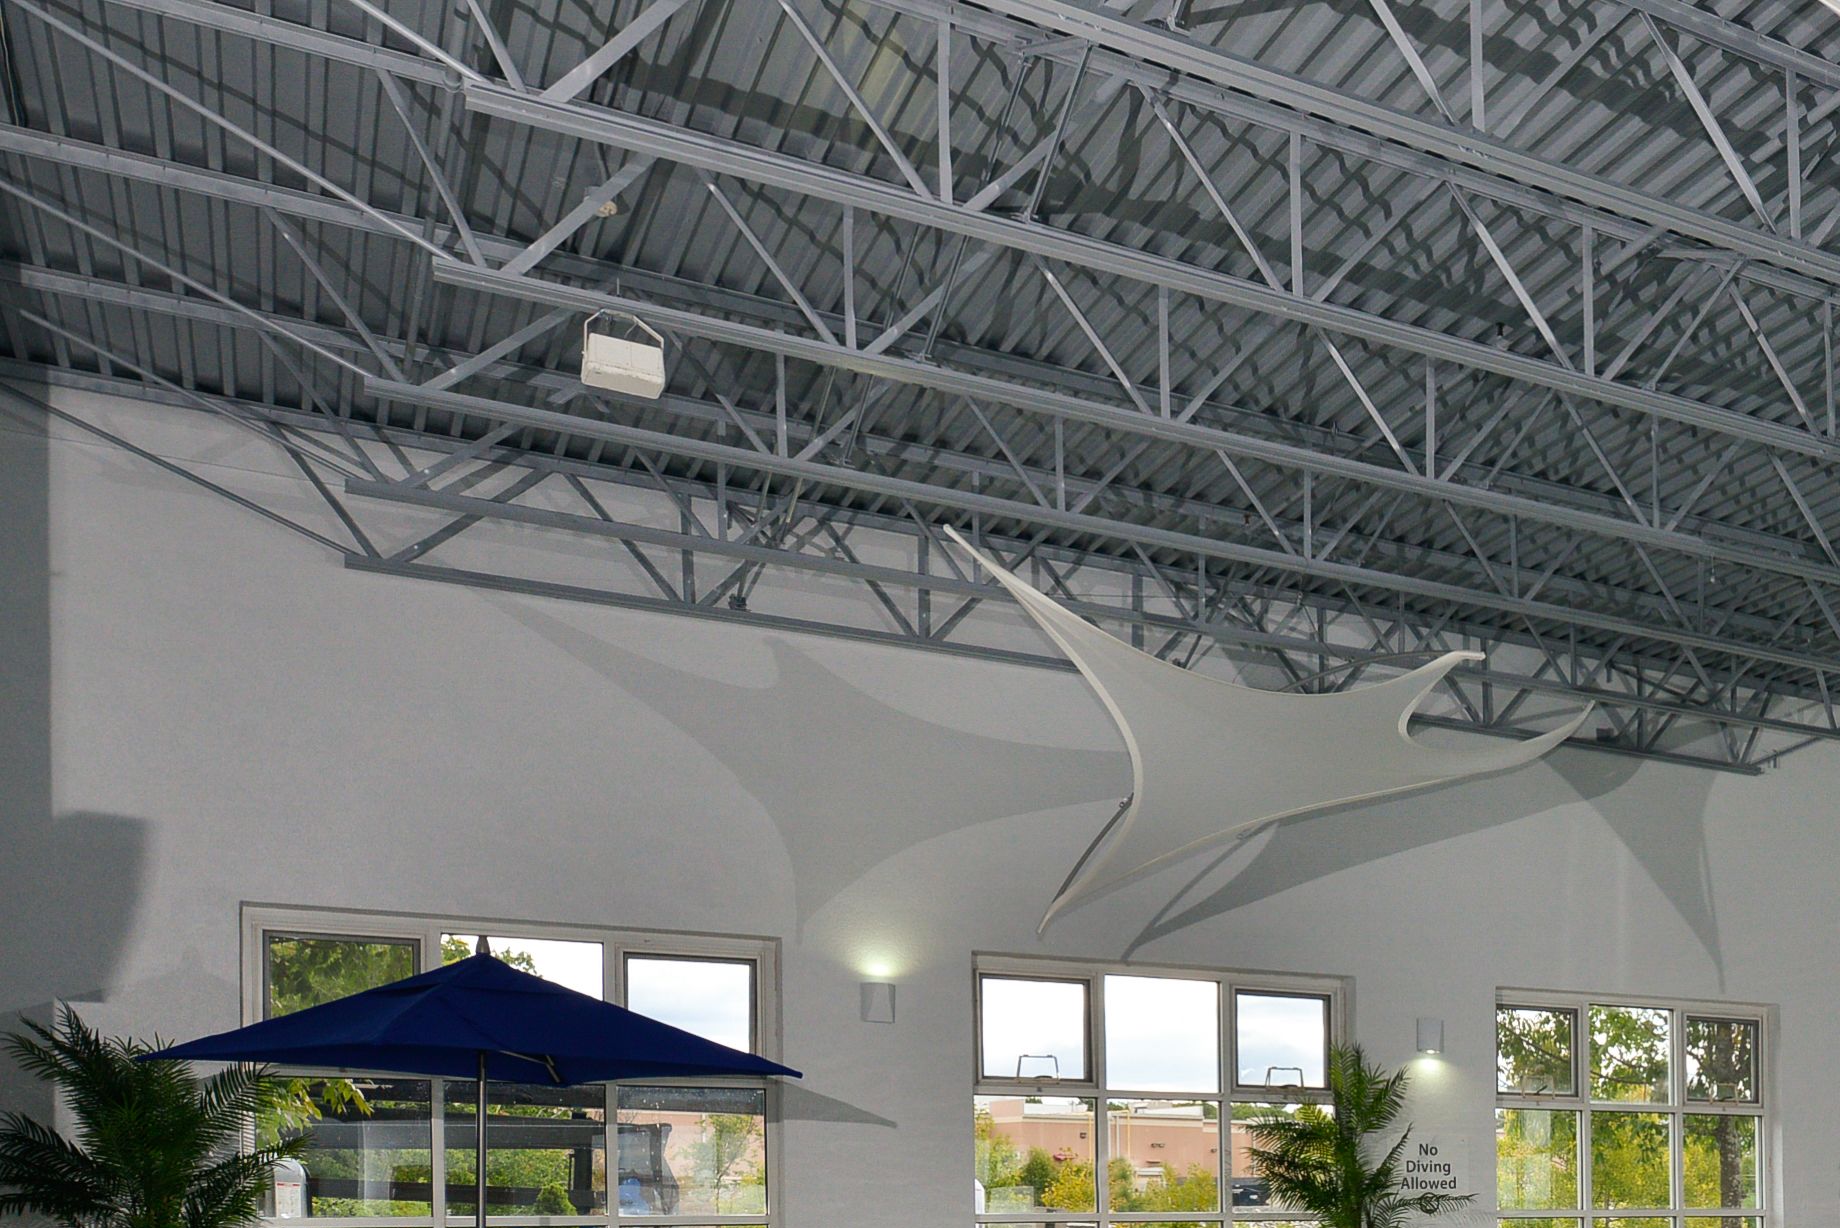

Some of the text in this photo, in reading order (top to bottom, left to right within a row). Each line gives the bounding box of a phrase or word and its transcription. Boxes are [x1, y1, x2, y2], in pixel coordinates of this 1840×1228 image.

[1419, 1143, 1438, 1156] No
[1406, 1160, 1451, 1176] Diving
[1400, 1176, 1457, 1190] Allowed
